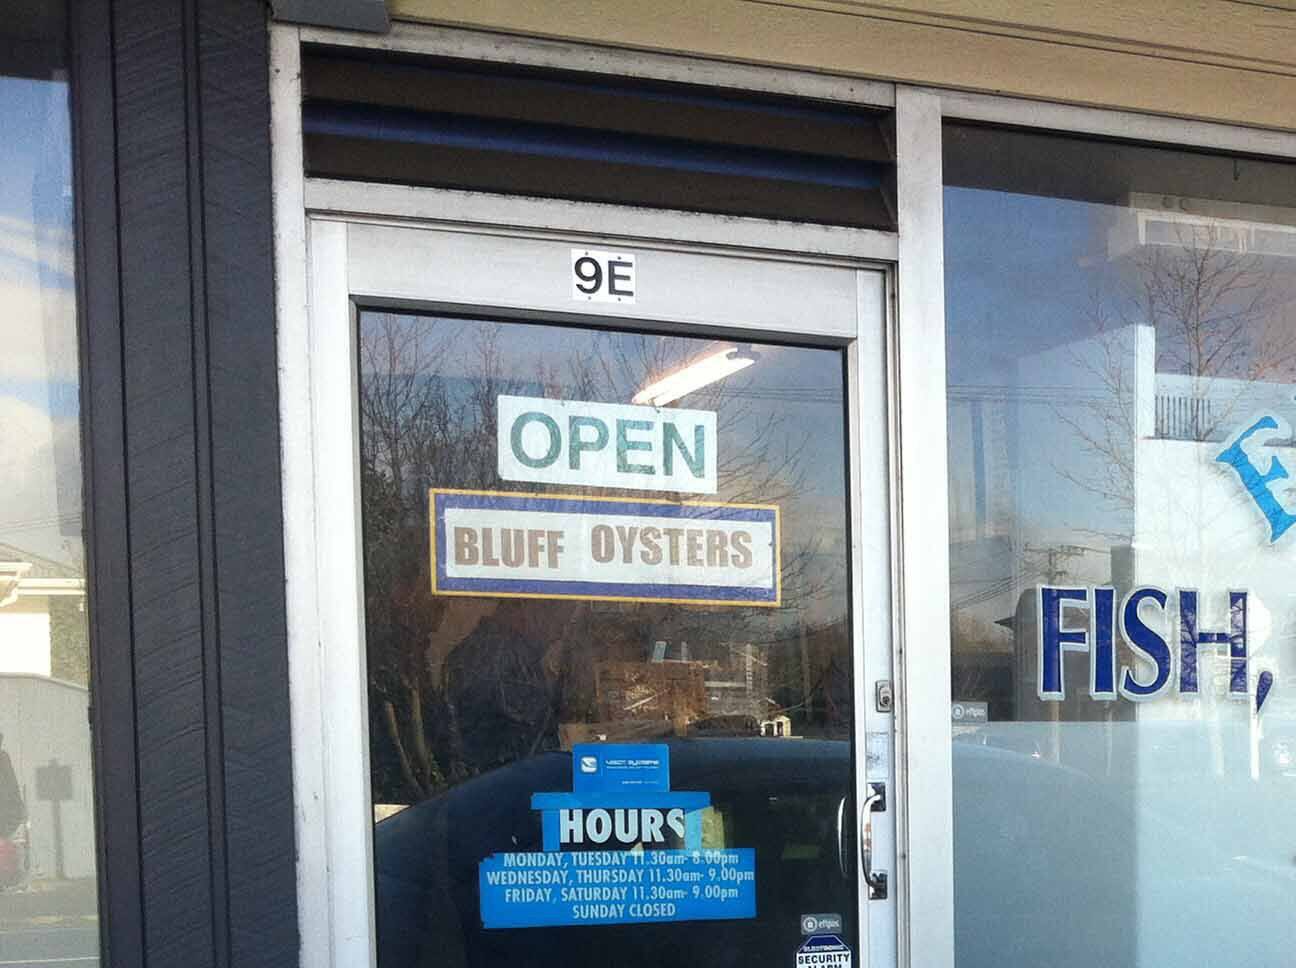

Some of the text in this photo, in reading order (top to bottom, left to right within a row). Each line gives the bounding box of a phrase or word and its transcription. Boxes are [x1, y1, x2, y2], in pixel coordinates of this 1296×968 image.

[574, 256, 634, 298] 9E
[509, 411, 706, 478] OPEN
[453, 524, 754, 569] BLUFF OYSTERS
[1036, 584, 1273, 714] FISH,
[560, 808, 686, 844] HOURS
[503, 851, 569, 869] MONDAY,
[571, 851, 628, 867] TUESDAY
[486, 866, 755, 887] WEDNESDAY, THURSDAY 11.30am- 9.00pm
[505, 883, 739, 904] FRIDAY, SATURDAY 11.30am- 9.00pm
[572, 902, 677, 920] SUNDAY CLOSED
[797, 953, 850, 965] SECURITY
